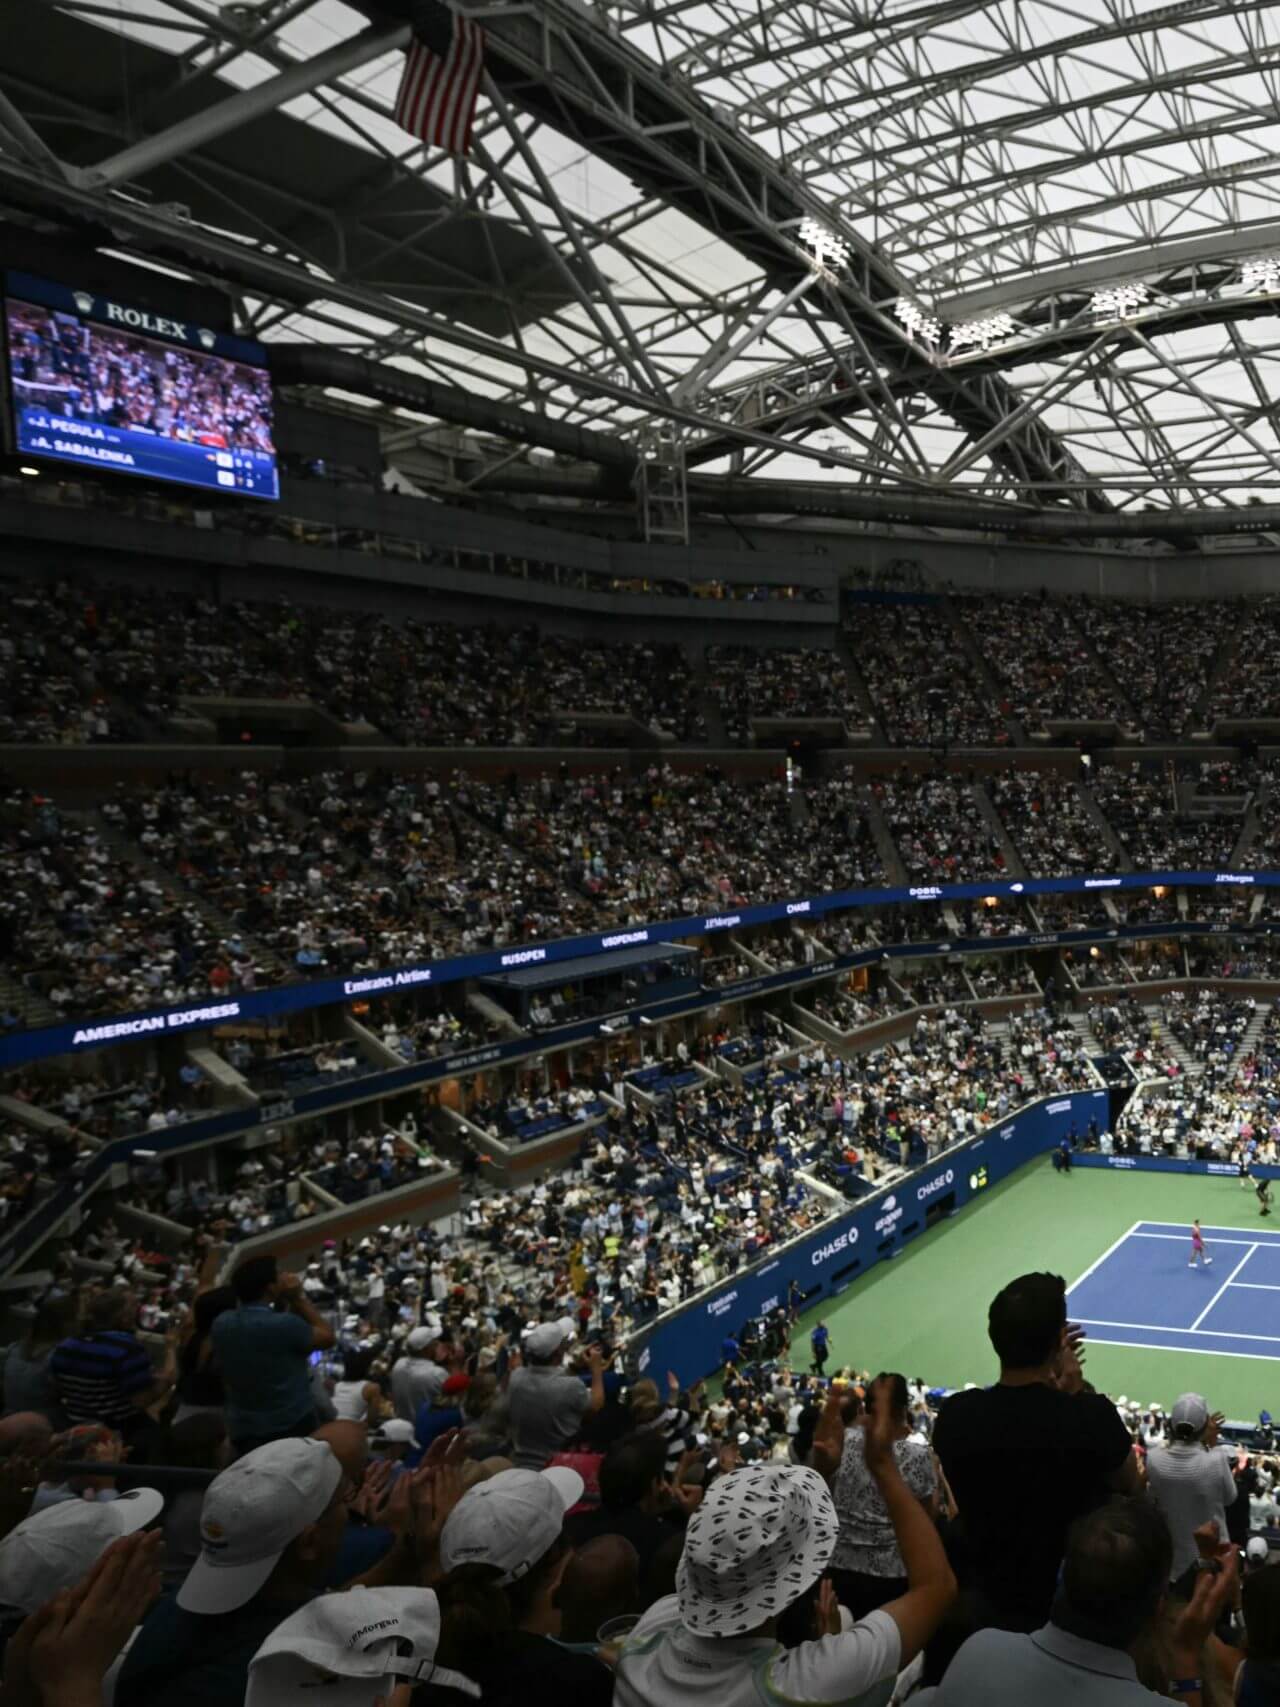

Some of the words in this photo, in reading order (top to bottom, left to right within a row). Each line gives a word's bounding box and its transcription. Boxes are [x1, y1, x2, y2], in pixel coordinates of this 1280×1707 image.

[106, 303, 188, 340] ROLEX
[50, 418, 105, 440] PEGULA
[54, 439, 135, 465] SABALENKA
[909, 887, 942, 896] DOBEL
[786, 901, 811, 914] CHASE
[602, 931, 648, 948] USOPEN.ORG
[1029, 935, 1057, 944] CHASE
[343, 976, 394, 994] Emirates
[395, 968, 432, 985] Airline
[72, 1016, 164, 1044] AMERICAN
[167, 1002, 240, 1027] EXPRESS
[260, 1101, 295, 1122] IBM
[917, 1177, 946, 1200] CHASE
[811, 1234, 849, 1265] CHASE
[707, 1290, 738, 1314] Emirates
